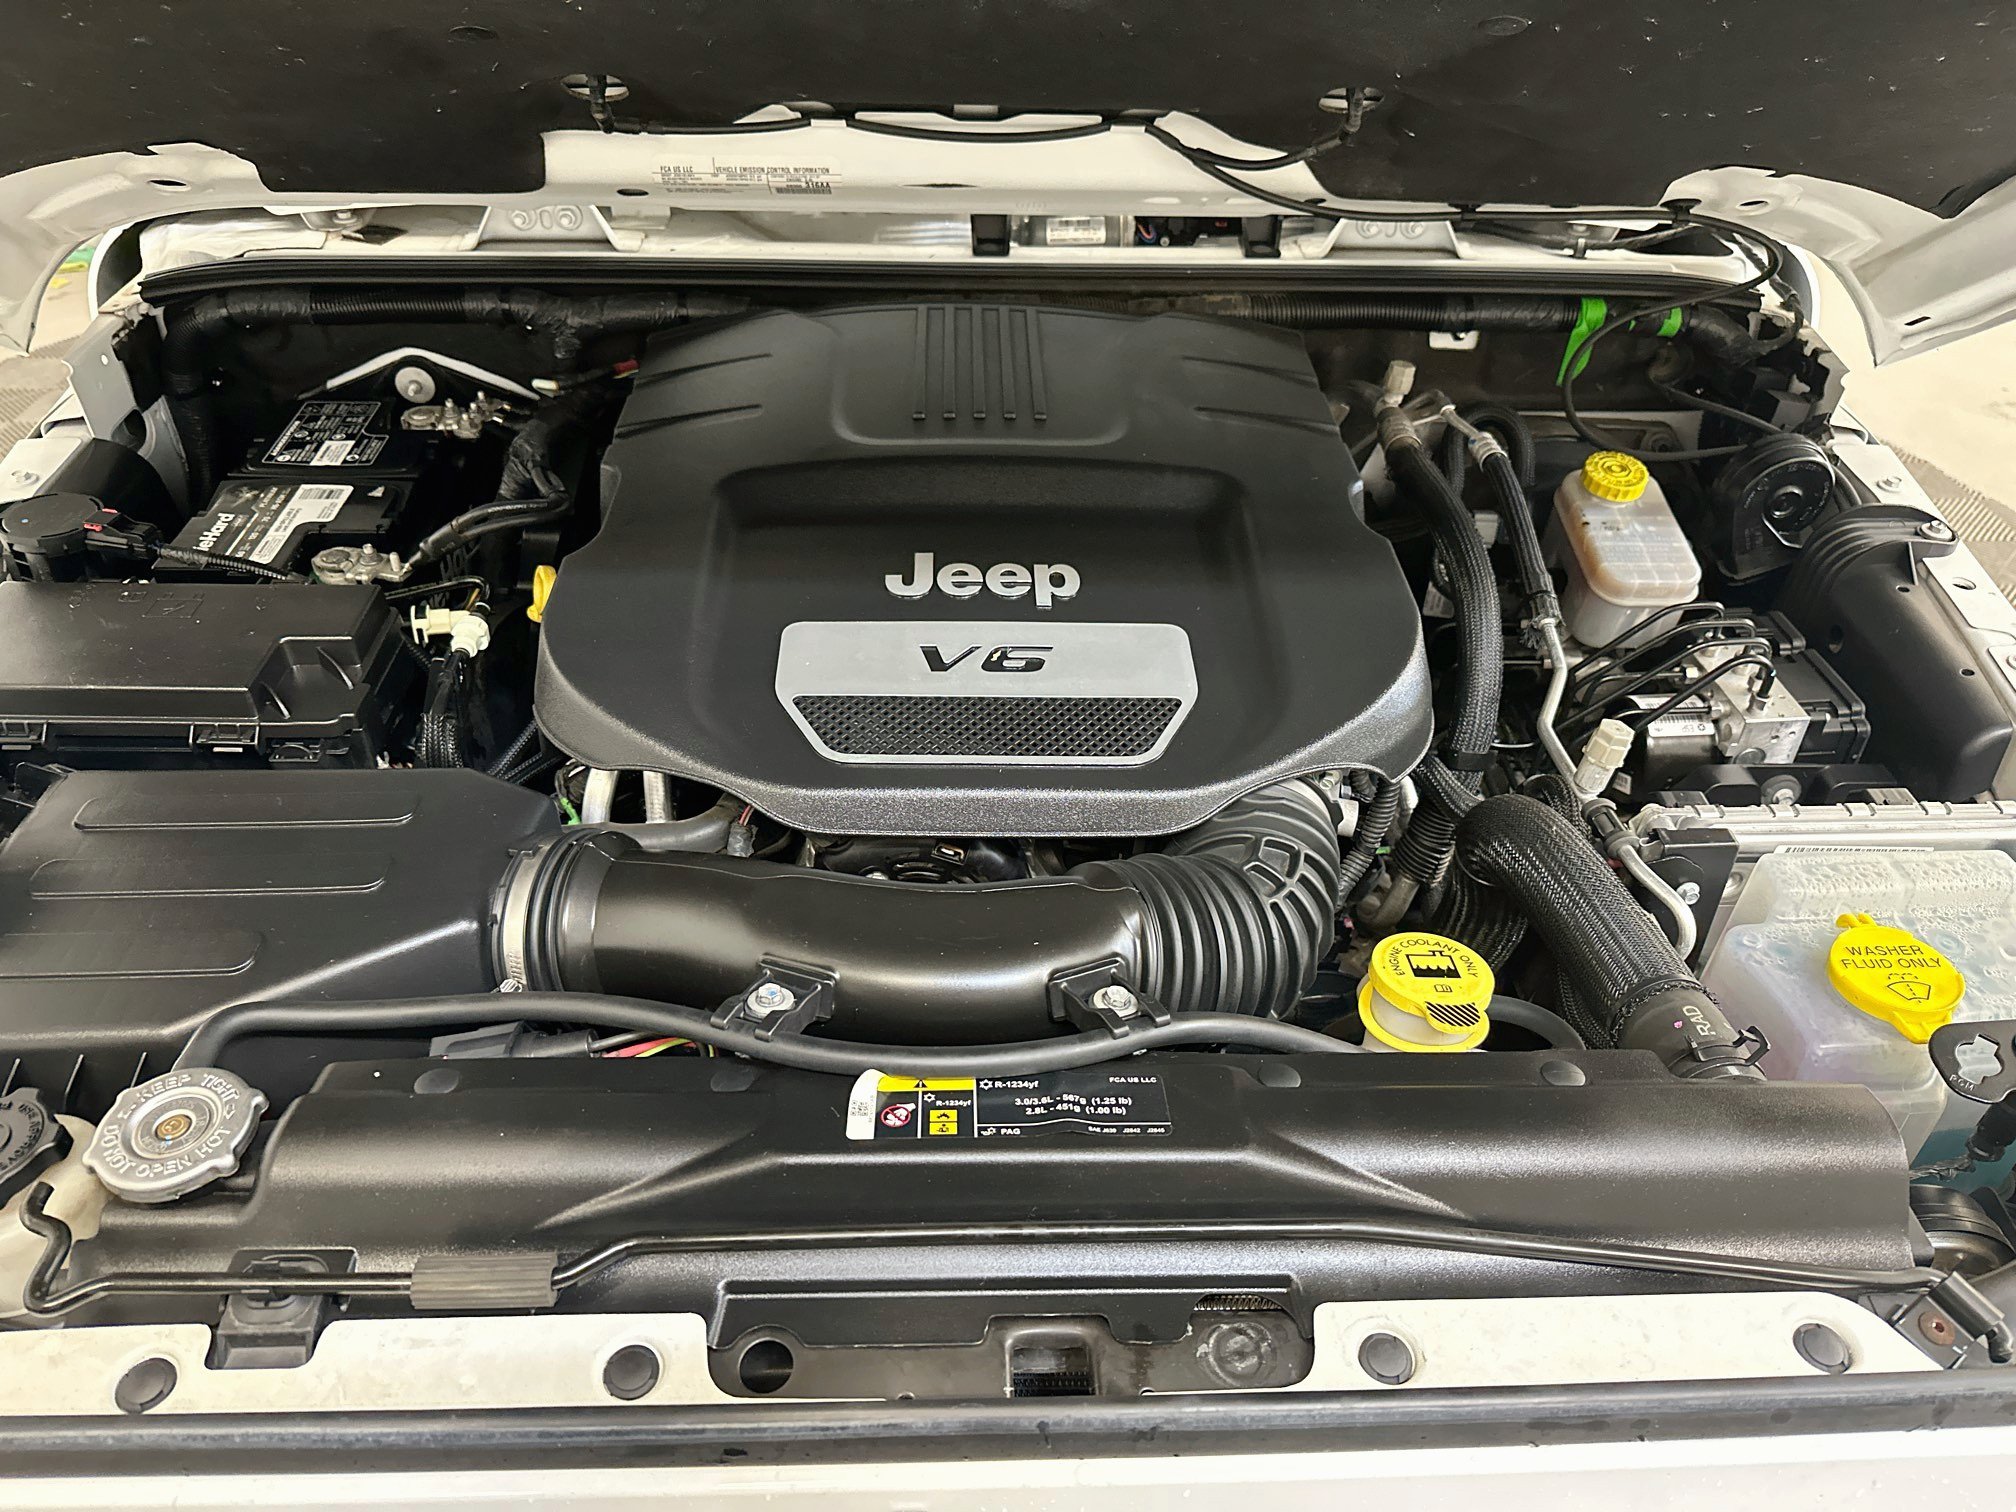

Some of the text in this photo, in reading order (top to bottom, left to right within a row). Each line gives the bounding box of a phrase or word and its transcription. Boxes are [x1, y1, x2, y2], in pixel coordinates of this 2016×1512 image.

[192, 512, 236, 551] ieHard
[885, 552, 1081, 610] Jeep
[919, 644, 1054, 673] V6
[1389, 938, 1478, 978] ENGINE COOLANT ONLY
[1841, 957, 1942, 969] FLUID ONLY
[1845, 945, 1924, 956] WASHER
[1682, 1005, 1711, 1036] RAD
[136, 1073, 240, 1102] KEEP TIGHT
[994, 1080, 1039, 1090] R-1234yf
[936, 1099, 972, 1107] R-1234yf
[1015, 1095, 1054, 1106] 3.0/3.6L
[1062, 1094, 1087, 1105] 567g
[1091, 1097, 1116, 1106] (1.25
[1118, 1097, 1132, 1106] lb)
[1025, 1106, 1047, 1115] 2.8L
[1055, 1103, 1081, 1113] 451g
[1085, 1106, 1110, 1115] (1.00
[1112, 1106, 1126, 1115] lb)
[136, 1154, 192, 1178] OPEN
[195, 1126, 231, 1159] HOT
